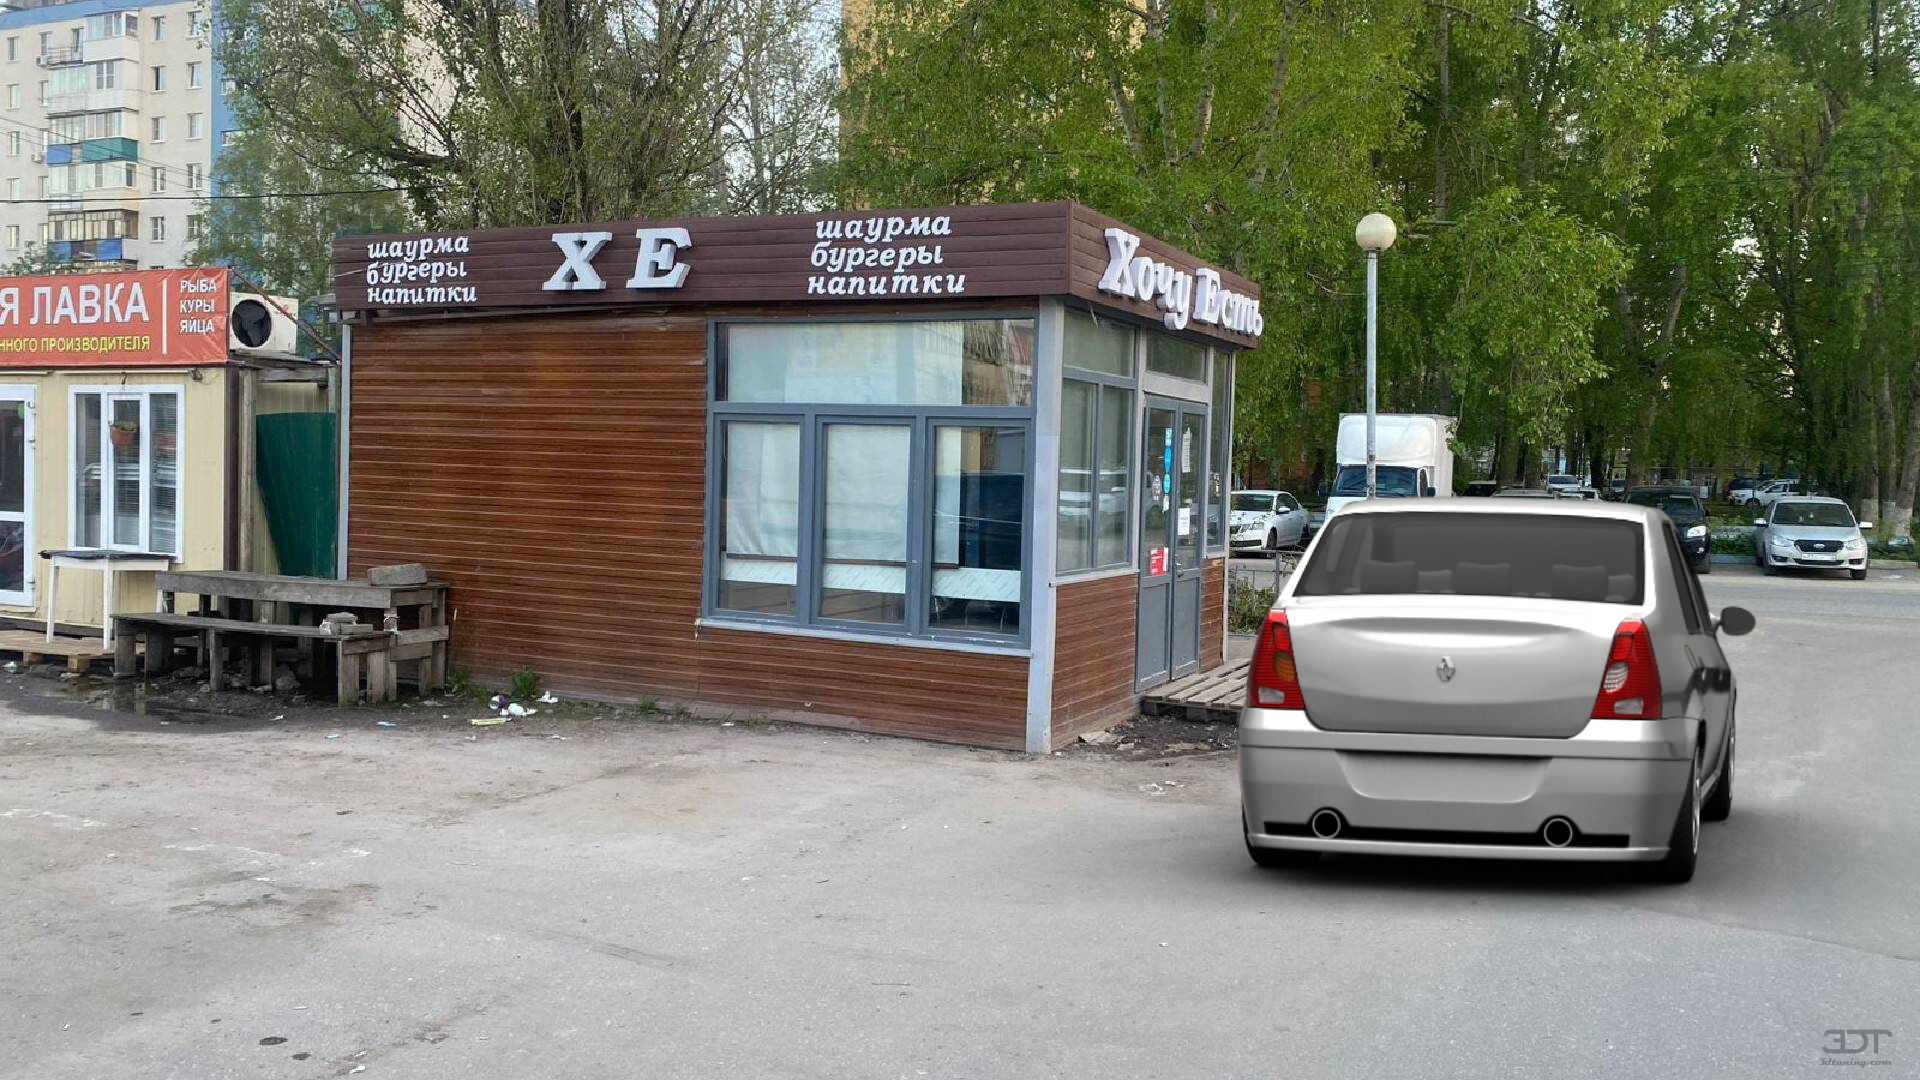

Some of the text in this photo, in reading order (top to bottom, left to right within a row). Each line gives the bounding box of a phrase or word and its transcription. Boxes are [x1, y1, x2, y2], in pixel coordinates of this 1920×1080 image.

[815, 215, 952, 245] шаурма
[367, 235, 470, 263] шаурма
[810, 241, 944, 273] бургеры
[366, 260, 468, 285] бургеры
[807, 271, 966, 296] напитки
[1098, 227, 1264, 337] Хочу Есть
[180, 279, 217, 293] РЫБА
[366, 285, 477, 305] напитки
[30, 282, 149, 324] ЛАВКА
[180, 299, 215, 313] КУРЫ
[180, 316, 215, 336] ЯЙЦА
[41, 335, 151, 353] ПРОИЗВОДИТЕЛЯ
